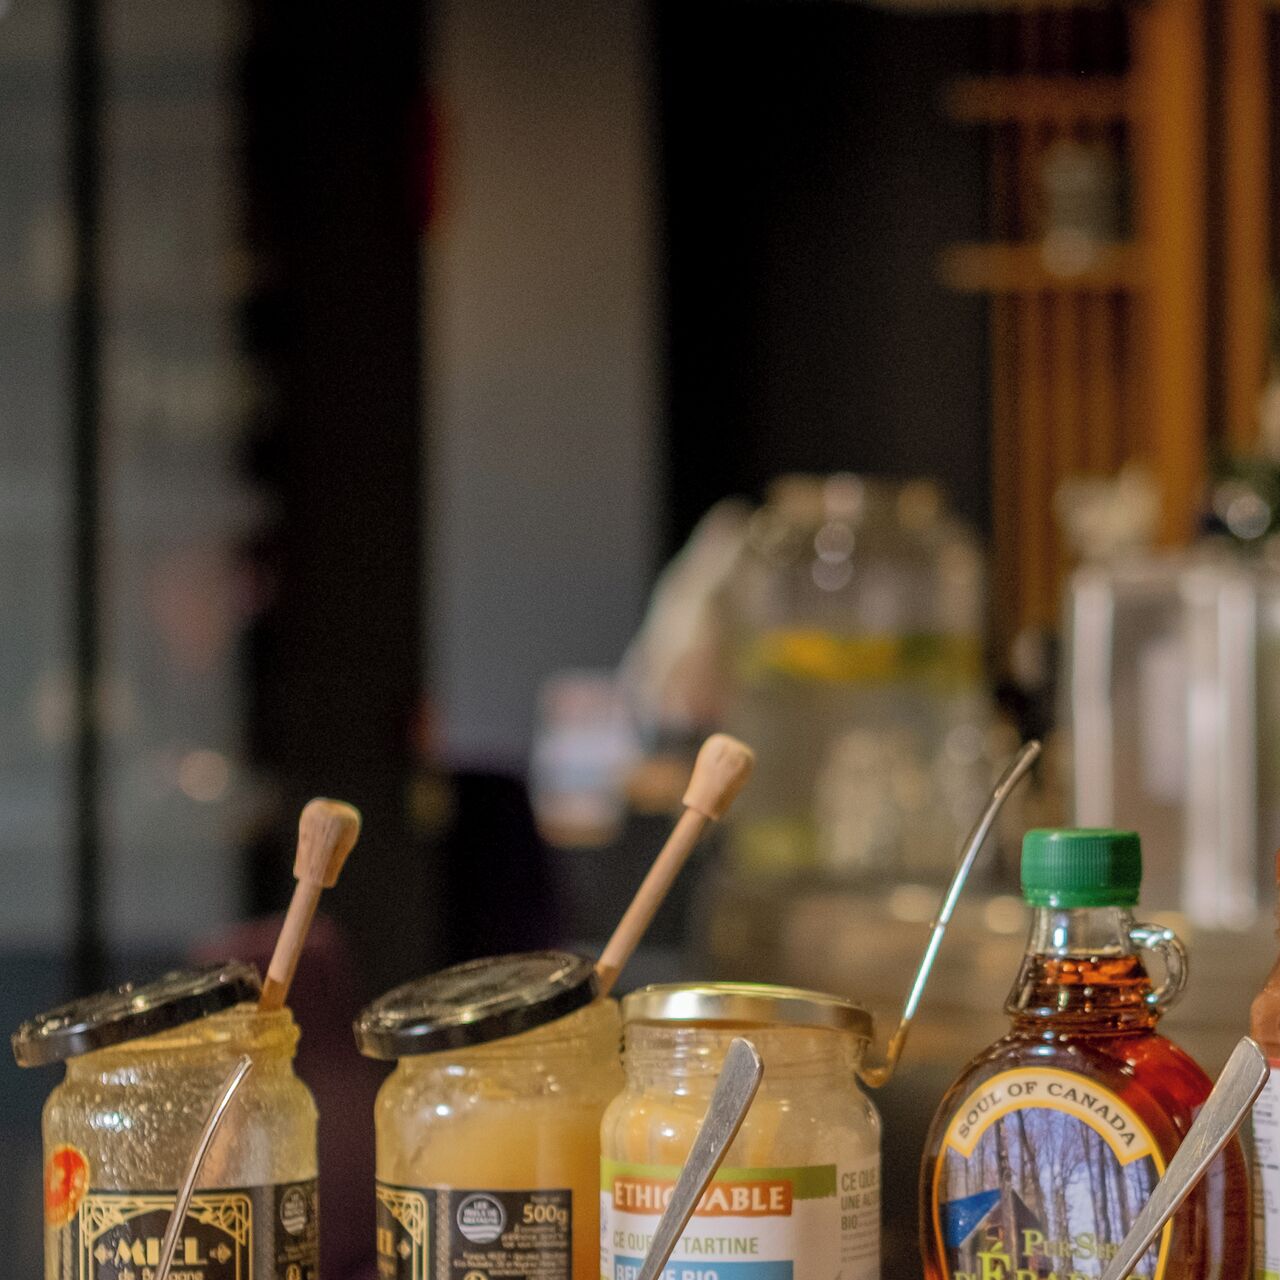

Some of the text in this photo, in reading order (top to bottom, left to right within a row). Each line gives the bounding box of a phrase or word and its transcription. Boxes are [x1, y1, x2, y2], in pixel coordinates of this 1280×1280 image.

[959, 1081, 1136, 1148] SOUL OF CANADA
[614, 1181, 786, 1212] ETHIABLE
[523, 1203, 568, 1230] 500g
[613, 1230, 626, 1249] CE
[683, 1236, 759, 1255] TARTINE
